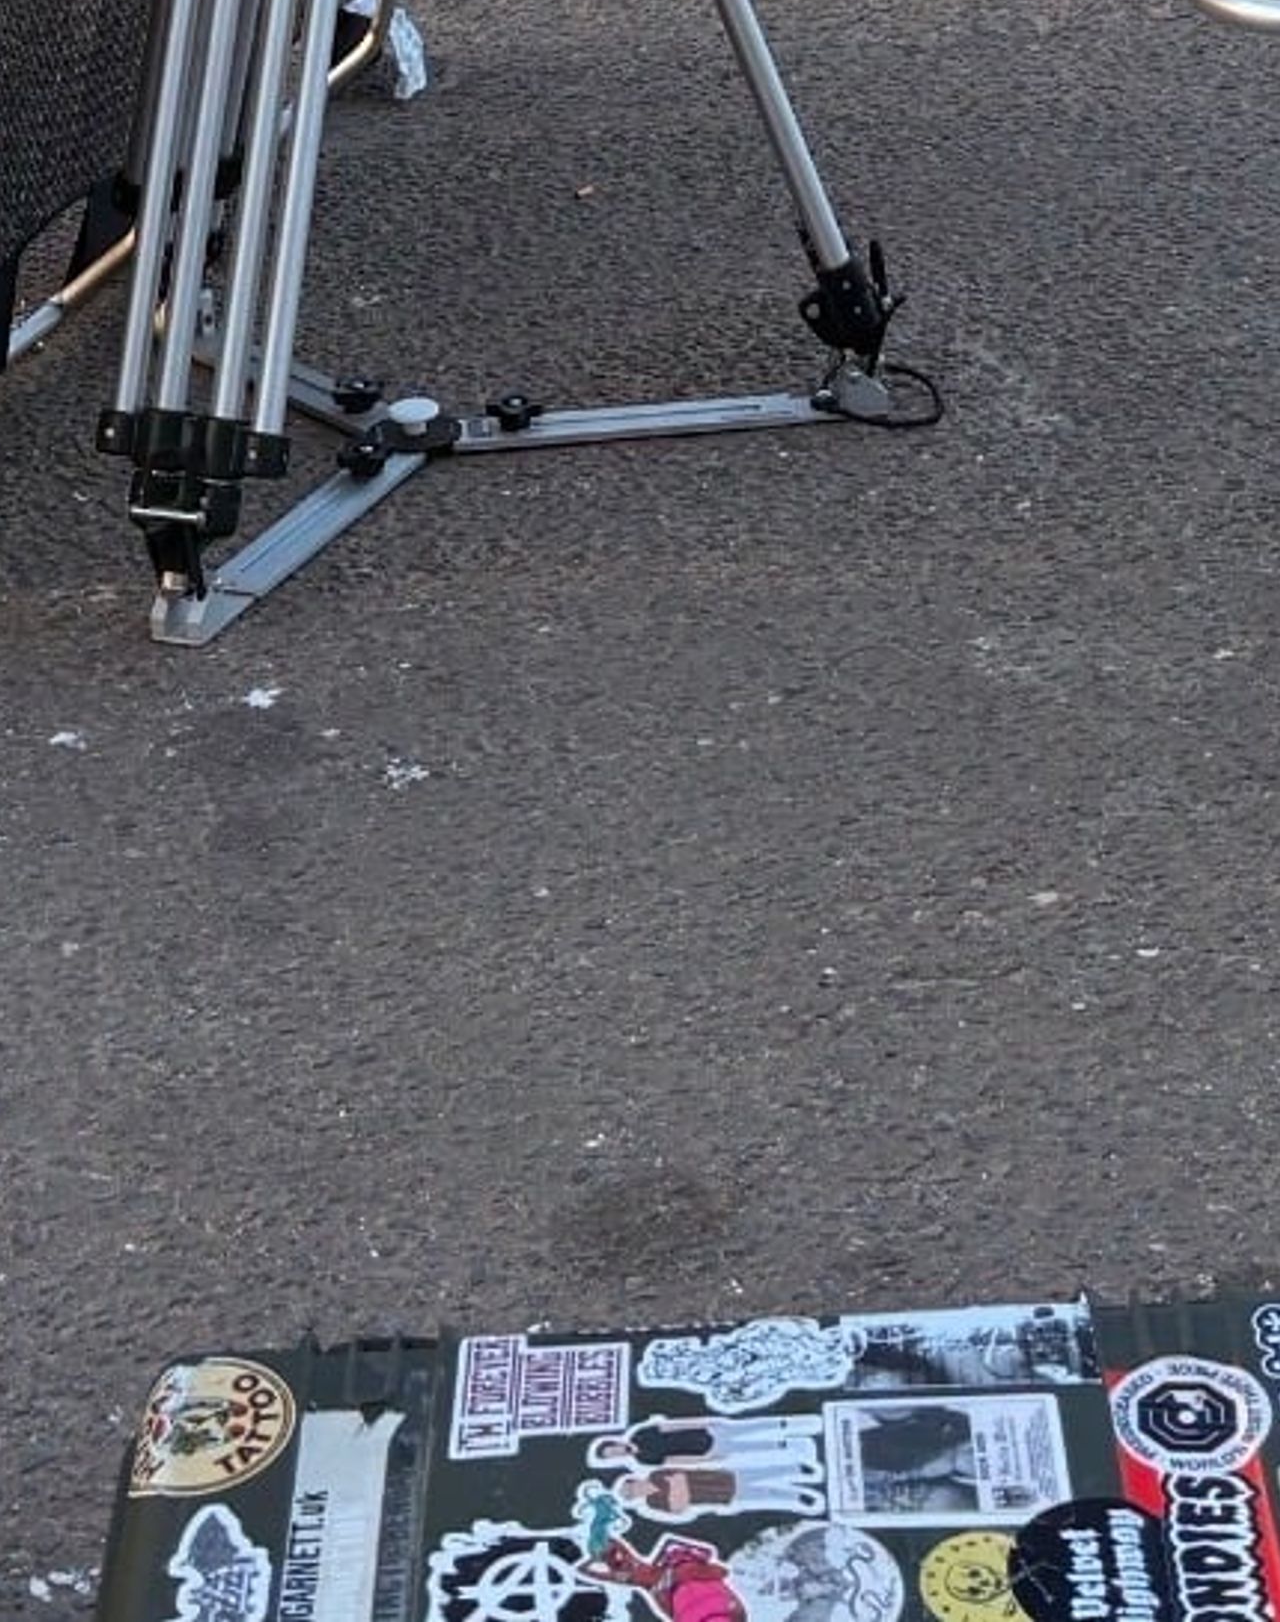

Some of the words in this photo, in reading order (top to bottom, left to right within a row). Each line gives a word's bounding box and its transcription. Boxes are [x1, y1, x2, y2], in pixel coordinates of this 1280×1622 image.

[468, 1337, 512, 1416] FOREVER
[520, 1350, 563, 1431] BLOWING
[573, 1348, 616, 1426] BUBBLES
[213, 1375, 275, 1475] TATTOO
[1060, 1526, 1111, 1620] Velvet
